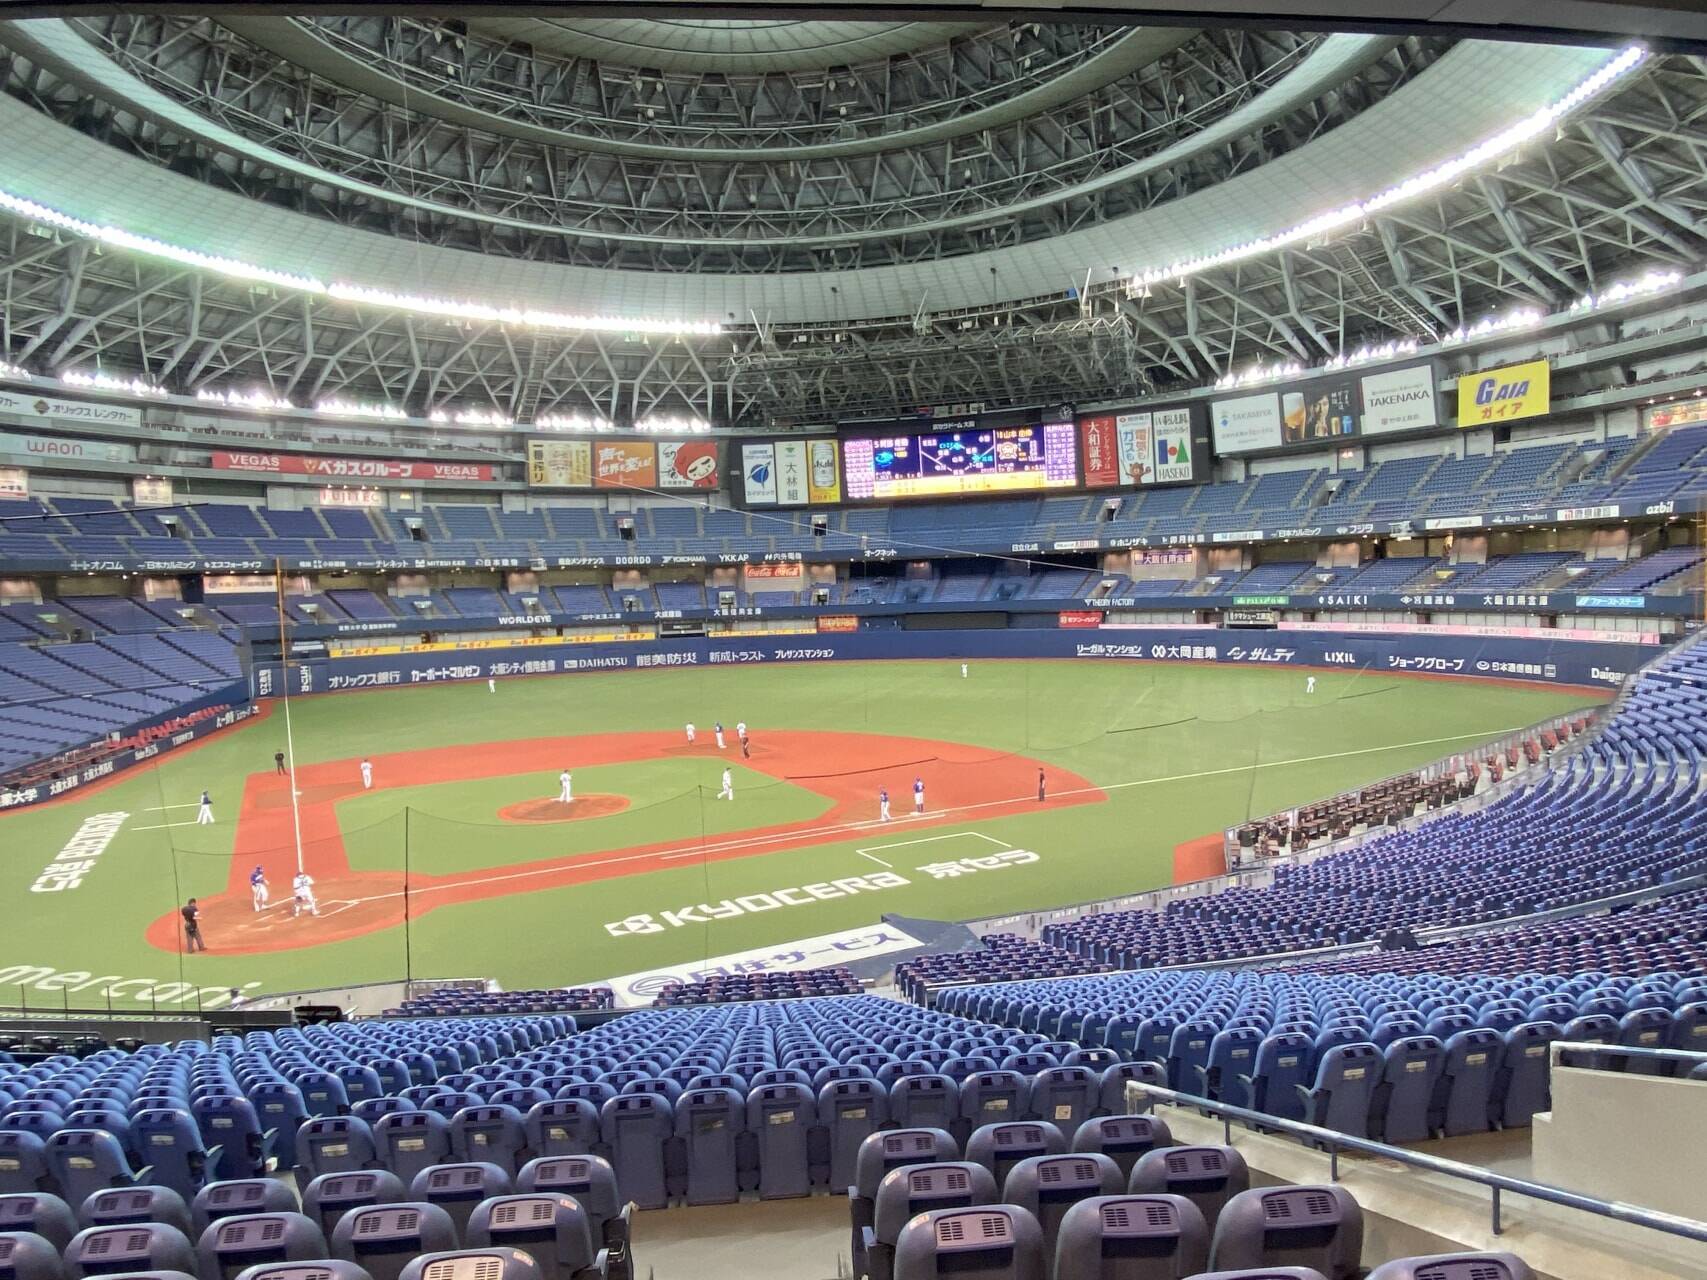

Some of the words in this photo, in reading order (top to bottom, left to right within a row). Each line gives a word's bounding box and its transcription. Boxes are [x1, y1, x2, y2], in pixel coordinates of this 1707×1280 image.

[1368, 390, 1430, 408] TAKENAKA
[1475, 379, 1531, 406] GAIA
[1481, 402, 1524, 419] ガイア
[1088, 421, 1103, 473] 大和証券
[229, 454, 280, 467] VEGAS
[317, 460, 413, 478] ベガスグループ
[434, 464, 479, 475] VEGAS
[1159, 467, 1190, 481] HASEKO
[785, 462, 799, 502] 大林組
[1646, 500, 1674, 515] azbil
[719, 554, 736, 562] YKK
[737, 553, 749, 562] AP
[1327, 595, 1368, 605] SAIKI
[579, 657, 628, 668] DAIHATSU
[636, 652, 697, 667] 能美防災
[709, 650, 766, 663] 新成トラスト
[1325, 652, 1356, 664] LIXIL
[1388, 655, 1465, 672] ショーワグローブ
[328, 671, 401, 690] オリックス銀行
[915, 848, 1041, 879] 京セラ
[660, 871, 911, 927] KYOCERA
